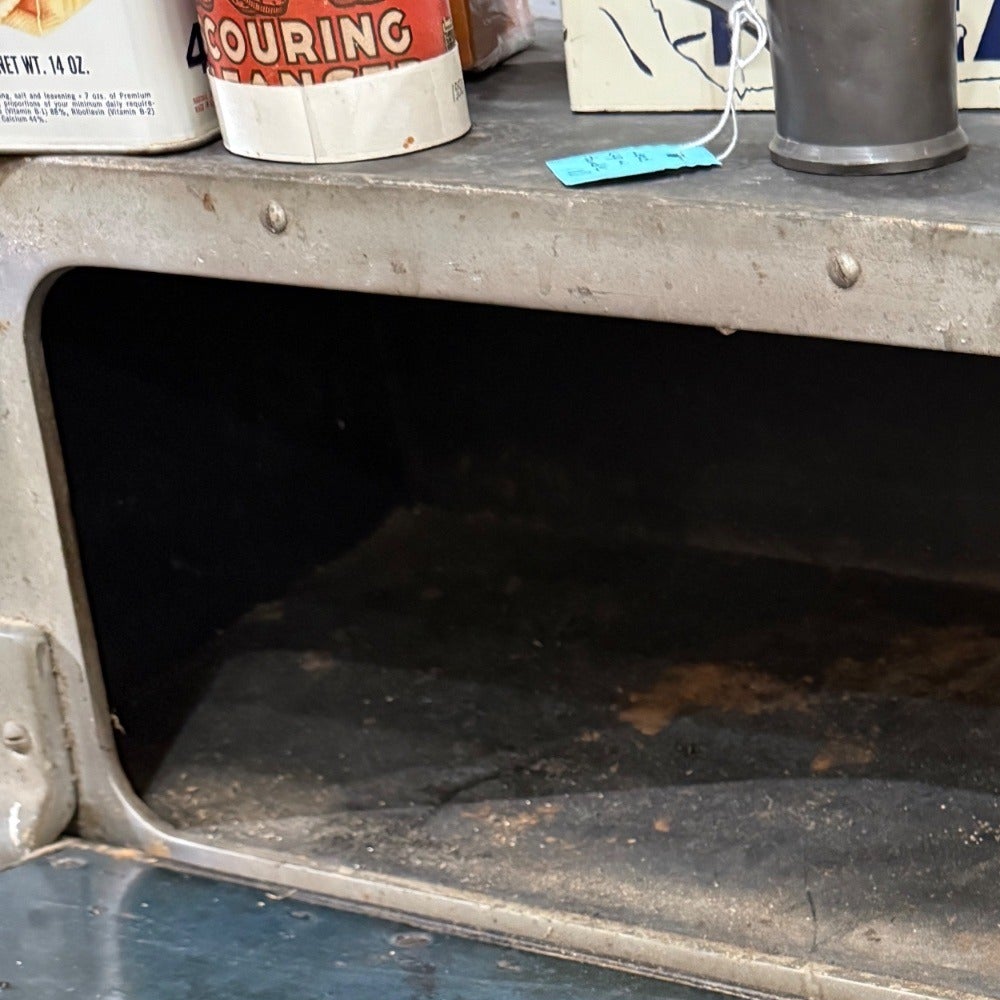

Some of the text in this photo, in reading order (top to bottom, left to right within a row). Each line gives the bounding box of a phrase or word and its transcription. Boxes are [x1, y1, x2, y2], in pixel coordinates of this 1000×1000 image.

[21, 55, 47, 75] WT.
[48, 55, 65, 75] 14
[67, 55, 90, 75] OZ.
[54, 101, 68, 109] your
[106, 101, 122, 109] daily
[108, 107, 137, 117] (Vitamin
